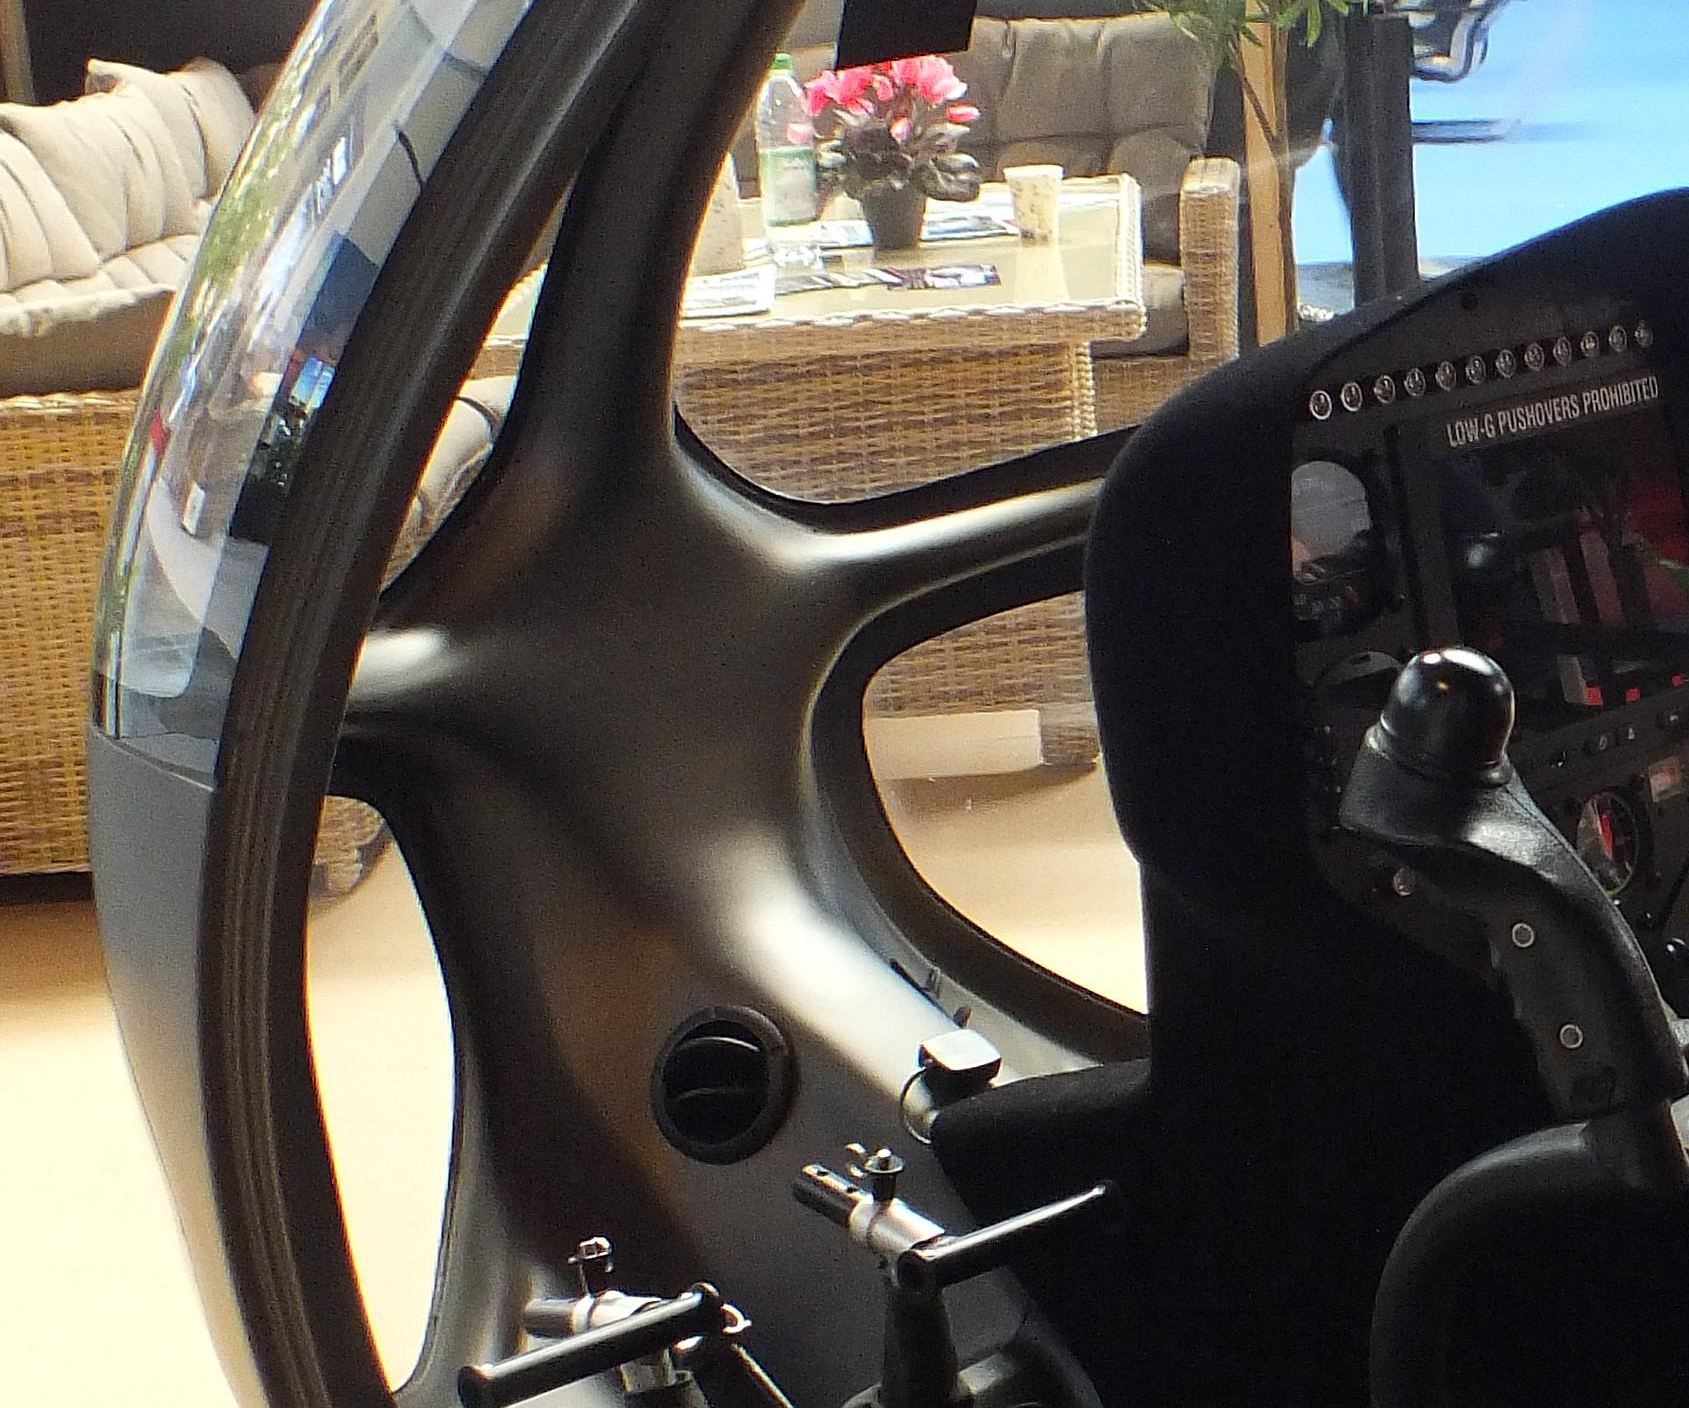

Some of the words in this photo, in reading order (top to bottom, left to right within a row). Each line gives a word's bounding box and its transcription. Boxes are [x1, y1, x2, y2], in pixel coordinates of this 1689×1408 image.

[1447, 414, 1496, 447] LOW-G
[1498, 396, 1579, 433] PUSHOVERS
[1583, 376, 1658, 413] PROHIBITED
